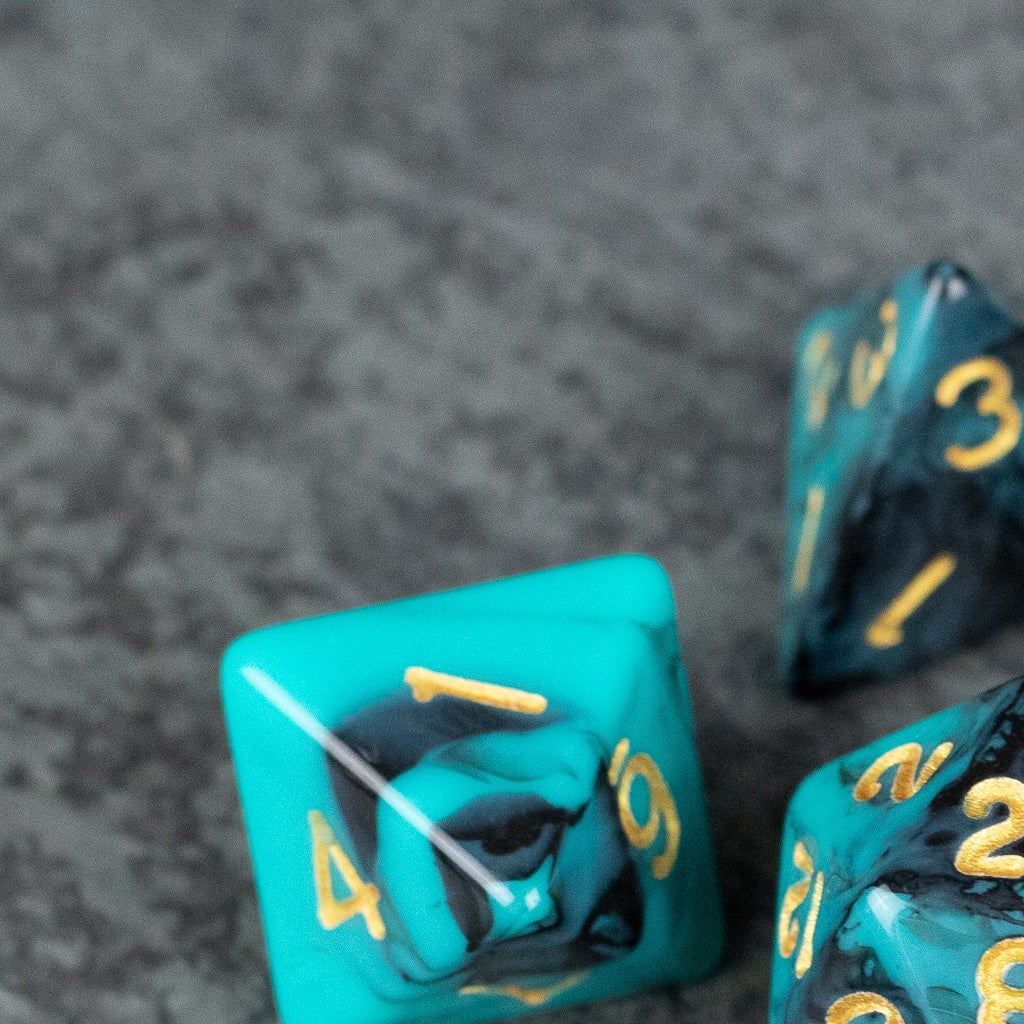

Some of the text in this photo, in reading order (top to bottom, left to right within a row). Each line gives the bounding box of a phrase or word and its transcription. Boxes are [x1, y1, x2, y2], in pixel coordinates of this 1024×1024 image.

[935, 355, 1021, 471] 3
[865, 552, 956, 648] 1
[405, 667, 547, 714] 1
[852, 742, 953, 802] 2
[308, 810, 386, 940] 4
